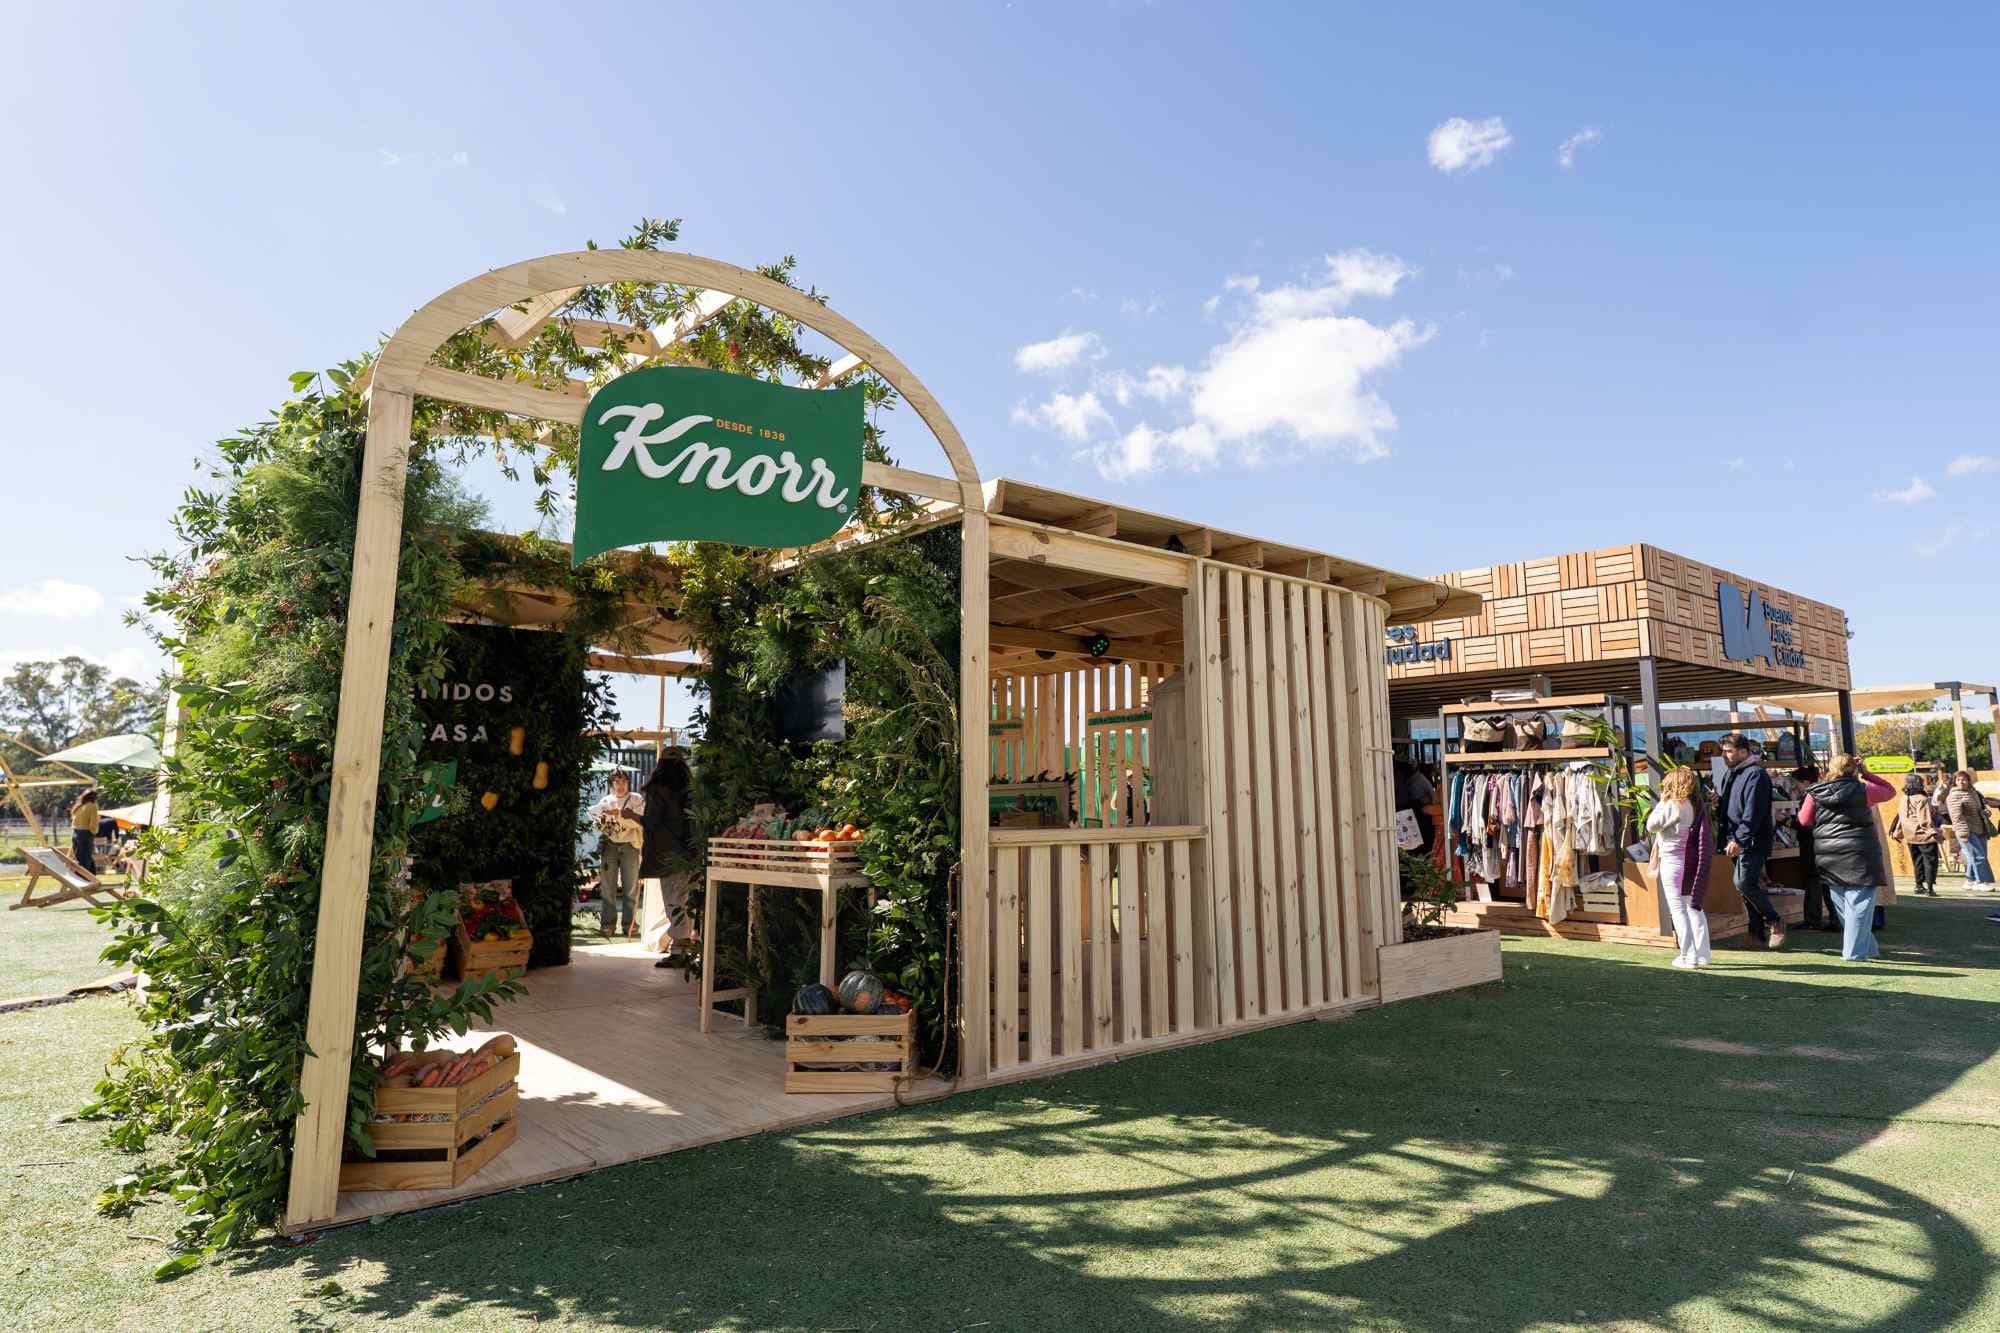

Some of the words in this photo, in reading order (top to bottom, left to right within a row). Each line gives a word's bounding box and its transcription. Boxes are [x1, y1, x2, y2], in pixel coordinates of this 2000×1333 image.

[715, 418, 753, 435] DESDE
[598, 402, 848, 509] Knorr
[1763, 602, 1793, 624] Buenos
[1384, 624, 1417, 641] es
[1384, 637, 1451, 664] iudad
[421, 723, 489, 742] ASA
